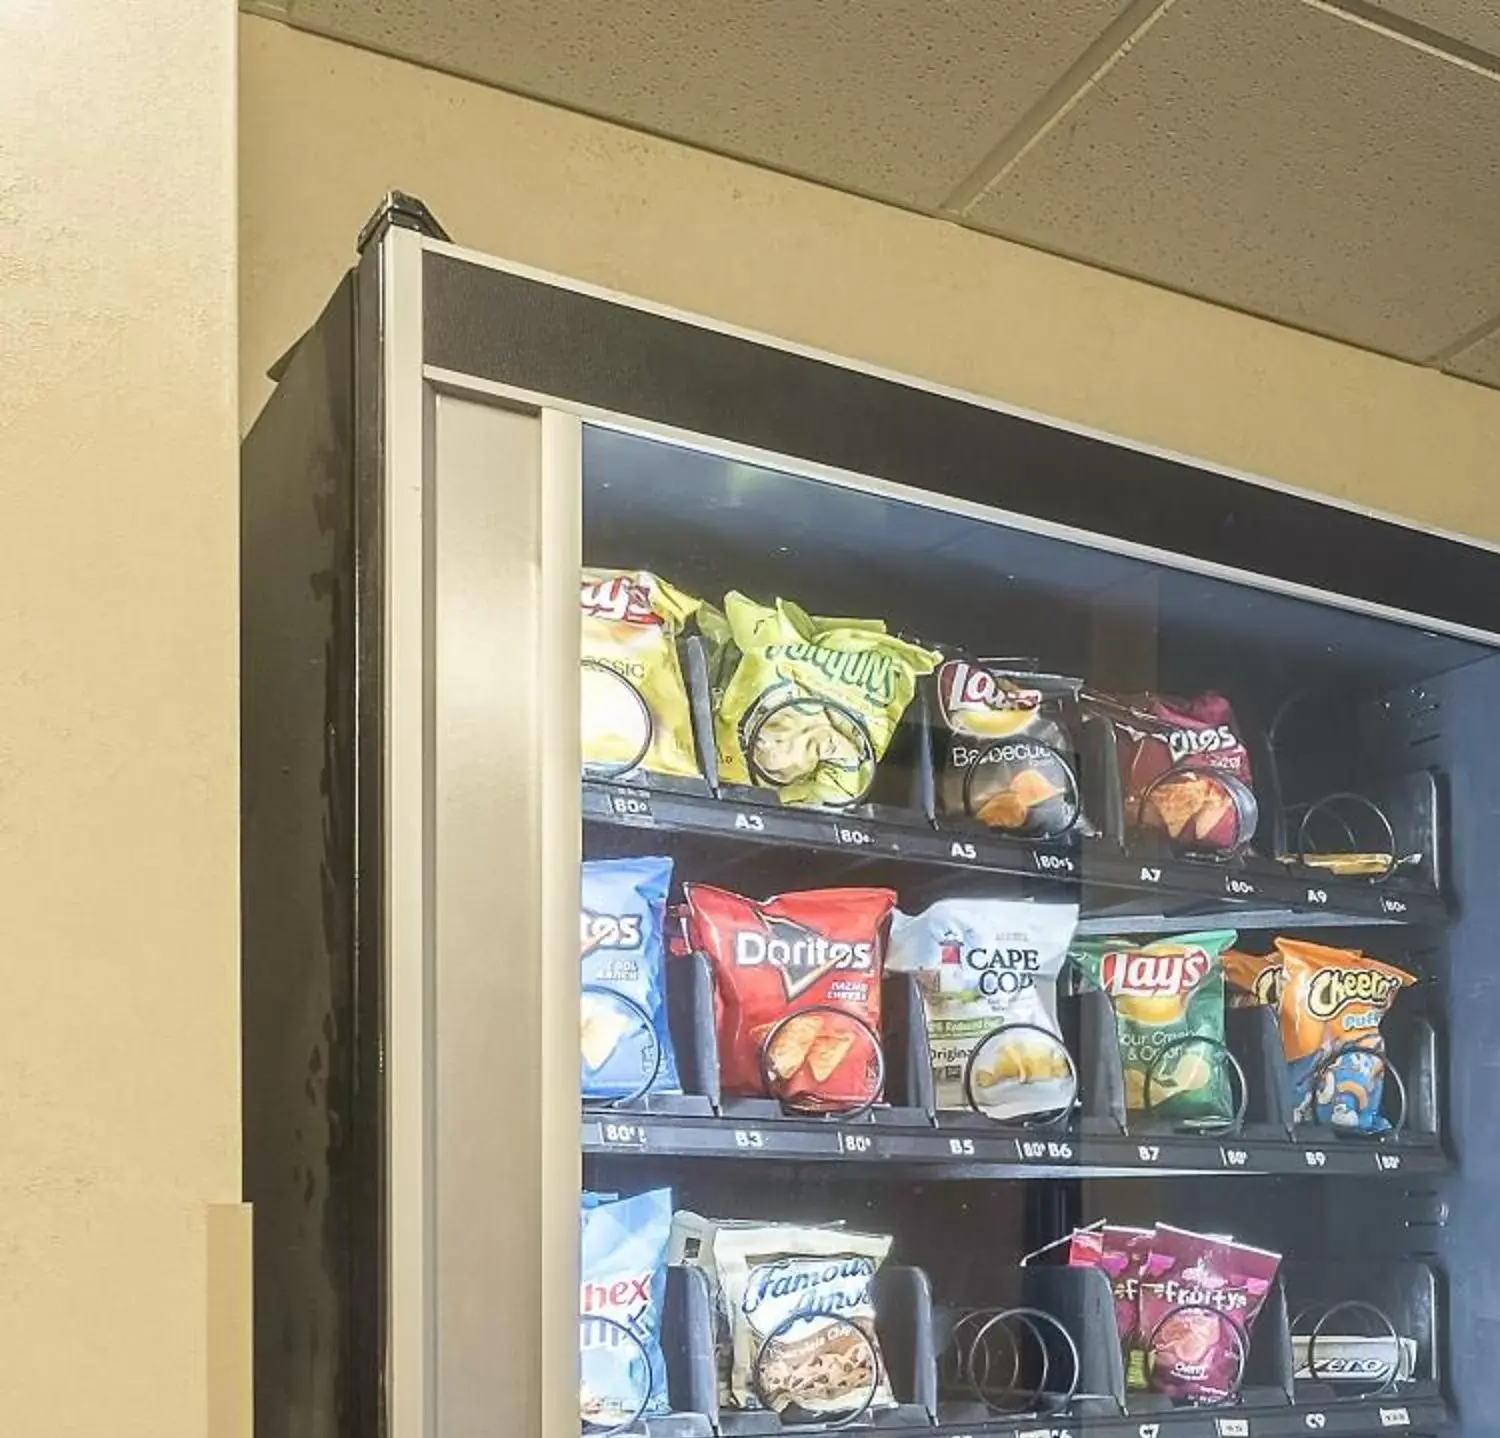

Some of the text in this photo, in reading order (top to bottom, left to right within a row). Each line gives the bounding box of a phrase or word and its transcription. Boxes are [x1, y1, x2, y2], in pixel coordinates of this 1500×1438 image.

[734, 813, 765, 832] A3
[951, 842, 977, 860] A5
[1140, 867, 1161, 882] A7
[1307, 889, 1327, 903] A9
[735, 931, 872, 970] Doritos
[966, 947, 1041, 971] CAPE
[1110, 951, 1206, 998] Lay's
[1120, 1033, 1147, 1047] our
[735, 1131, 763, 1148] B3
[950, 1139, 975, 1155] B5
[1049, 1144, 1073, 1159] B6
[1138, 1146, 1160, 1161] B7
[1305, 1151, 1327, 1167] B9
[584, 1273, 651, 1312] hex
[744, 1258, 874, 1311] Famous
[1305, 1412, 1326, 1429] C9
